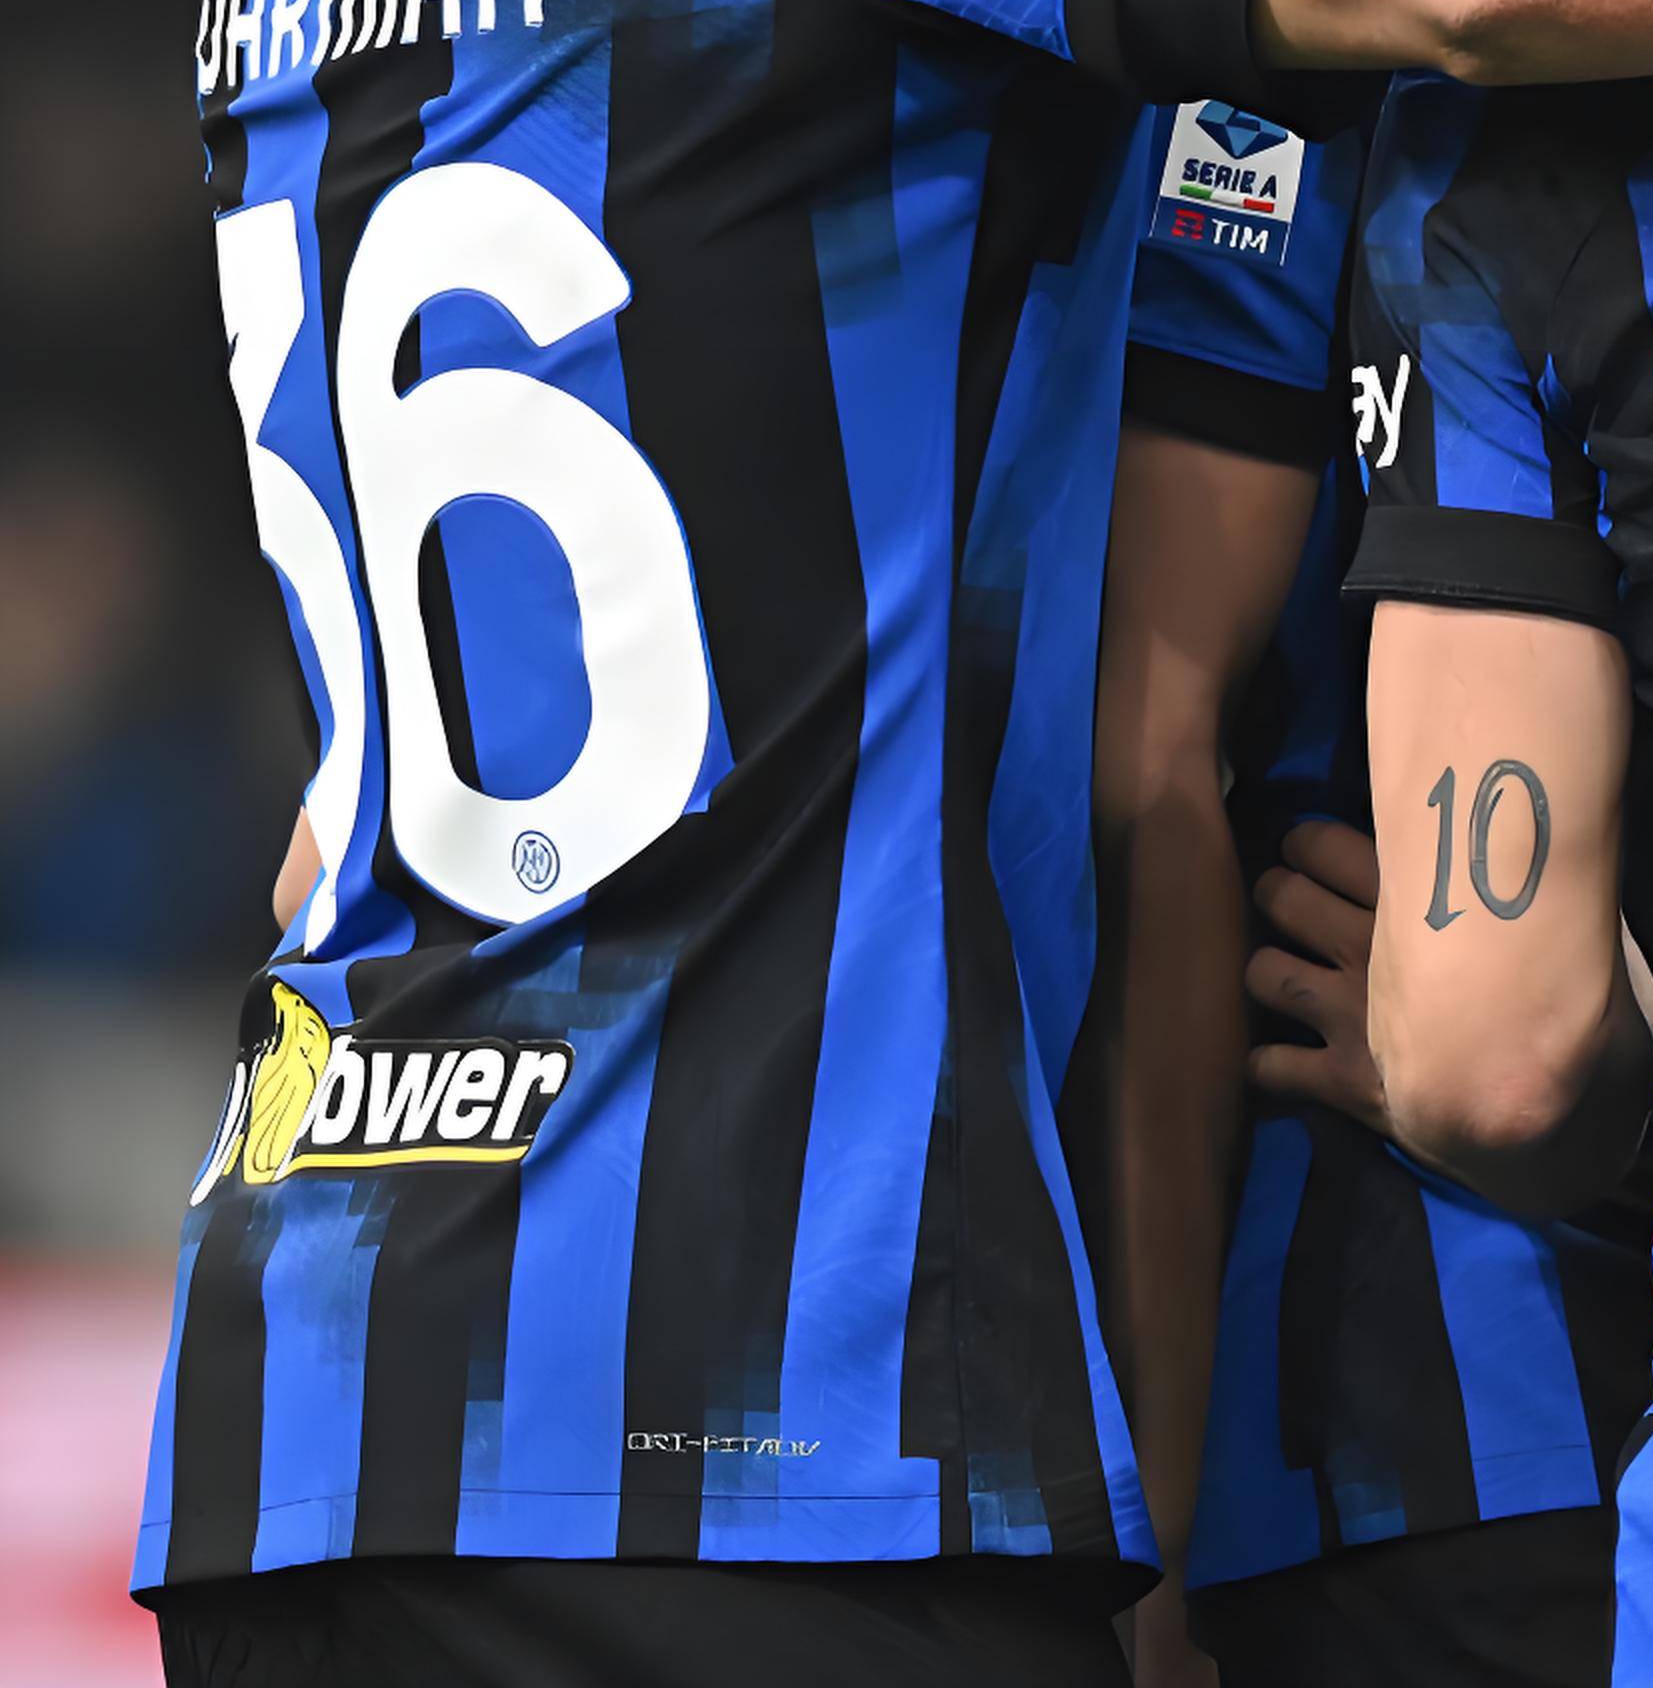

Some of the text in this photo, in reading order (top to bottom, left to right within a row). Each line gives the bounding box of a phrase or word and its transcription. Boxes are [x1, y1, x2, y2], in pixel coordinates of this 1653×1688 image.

[1259, 174, 1277, 199] A
[1211, 218, 1269, 253] TIM
[1424, 759, 1550, 931] 10
